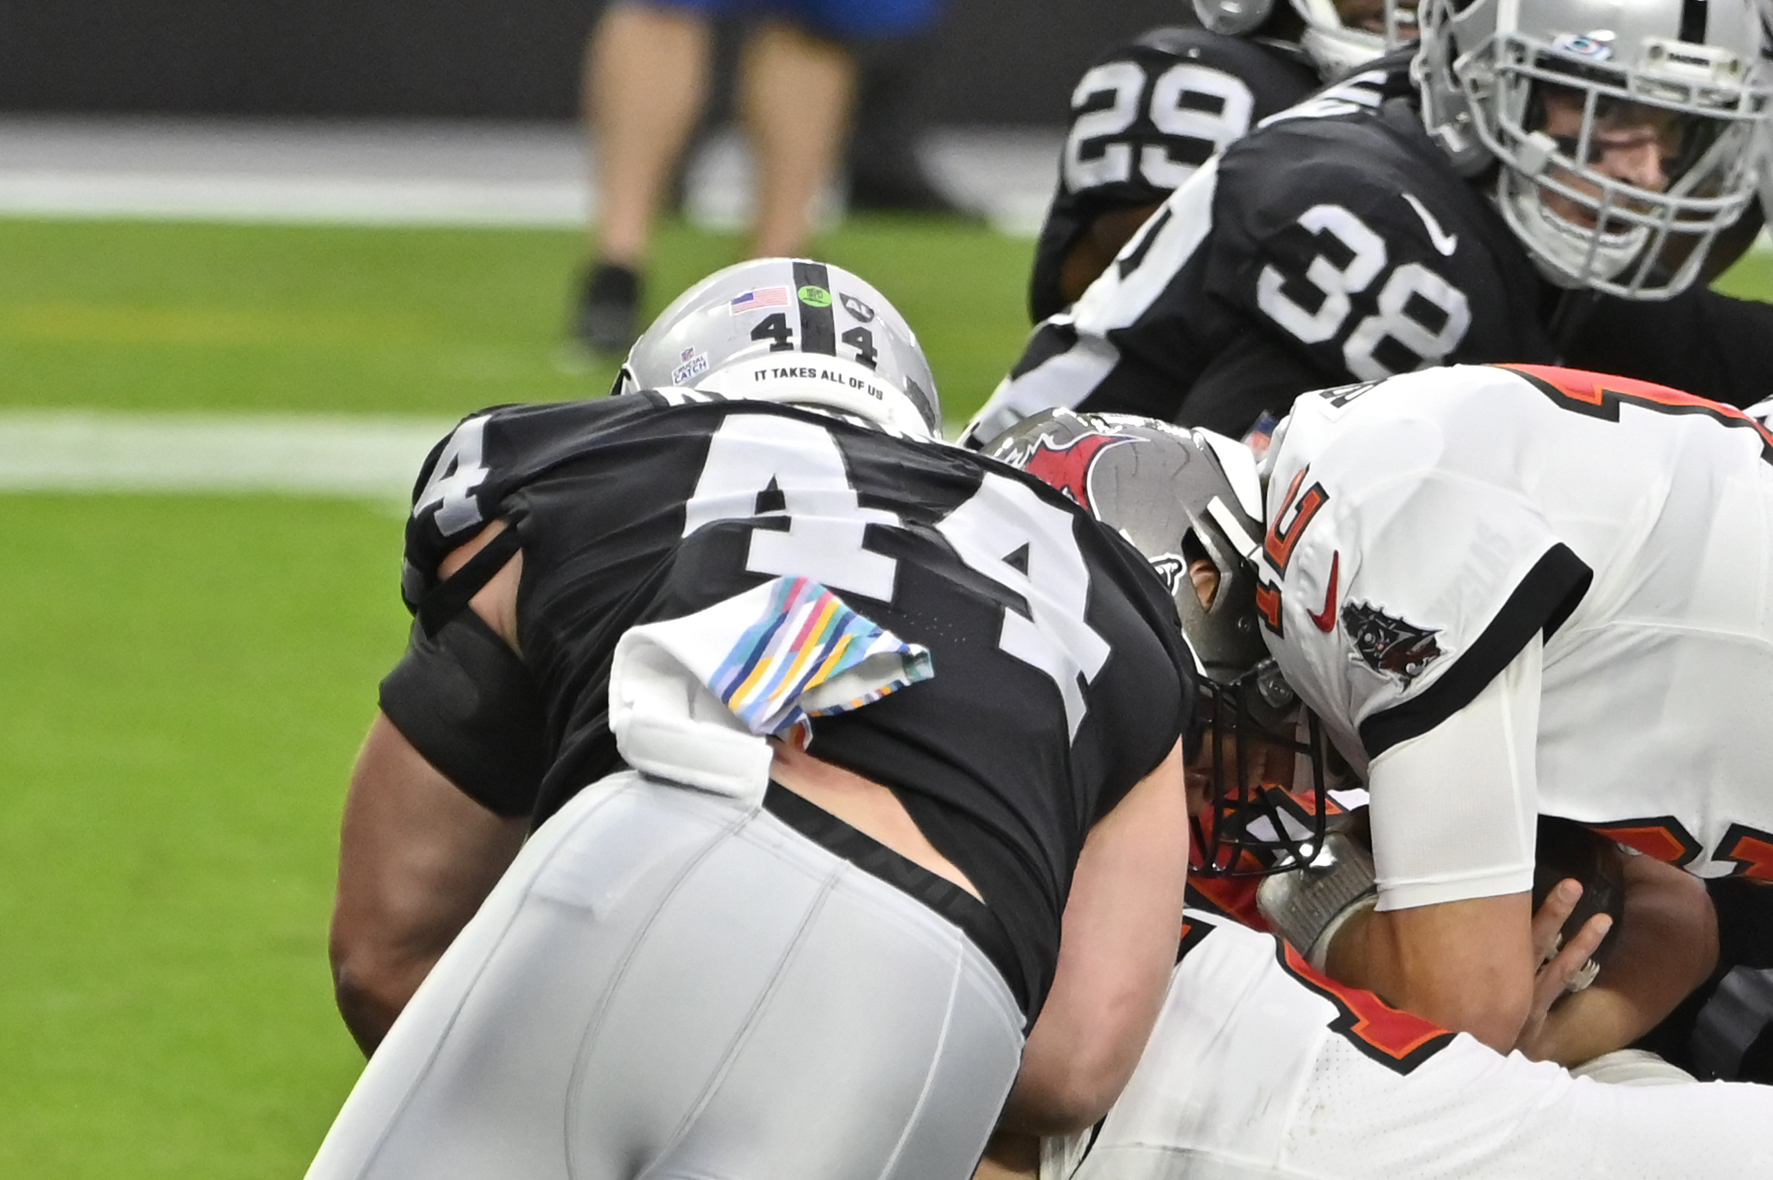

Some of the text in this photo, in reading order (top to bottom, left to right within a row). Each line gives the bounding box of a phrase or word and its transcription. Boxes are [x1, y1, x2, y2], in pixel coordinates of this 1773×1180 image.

[1064, 61, 1253, 194] 29
[1257, 203, 1472, 382] 38
[674, 360, 707, 384] CATCH
[754, 367, 884, 401] IT TAKES ALL OF US
